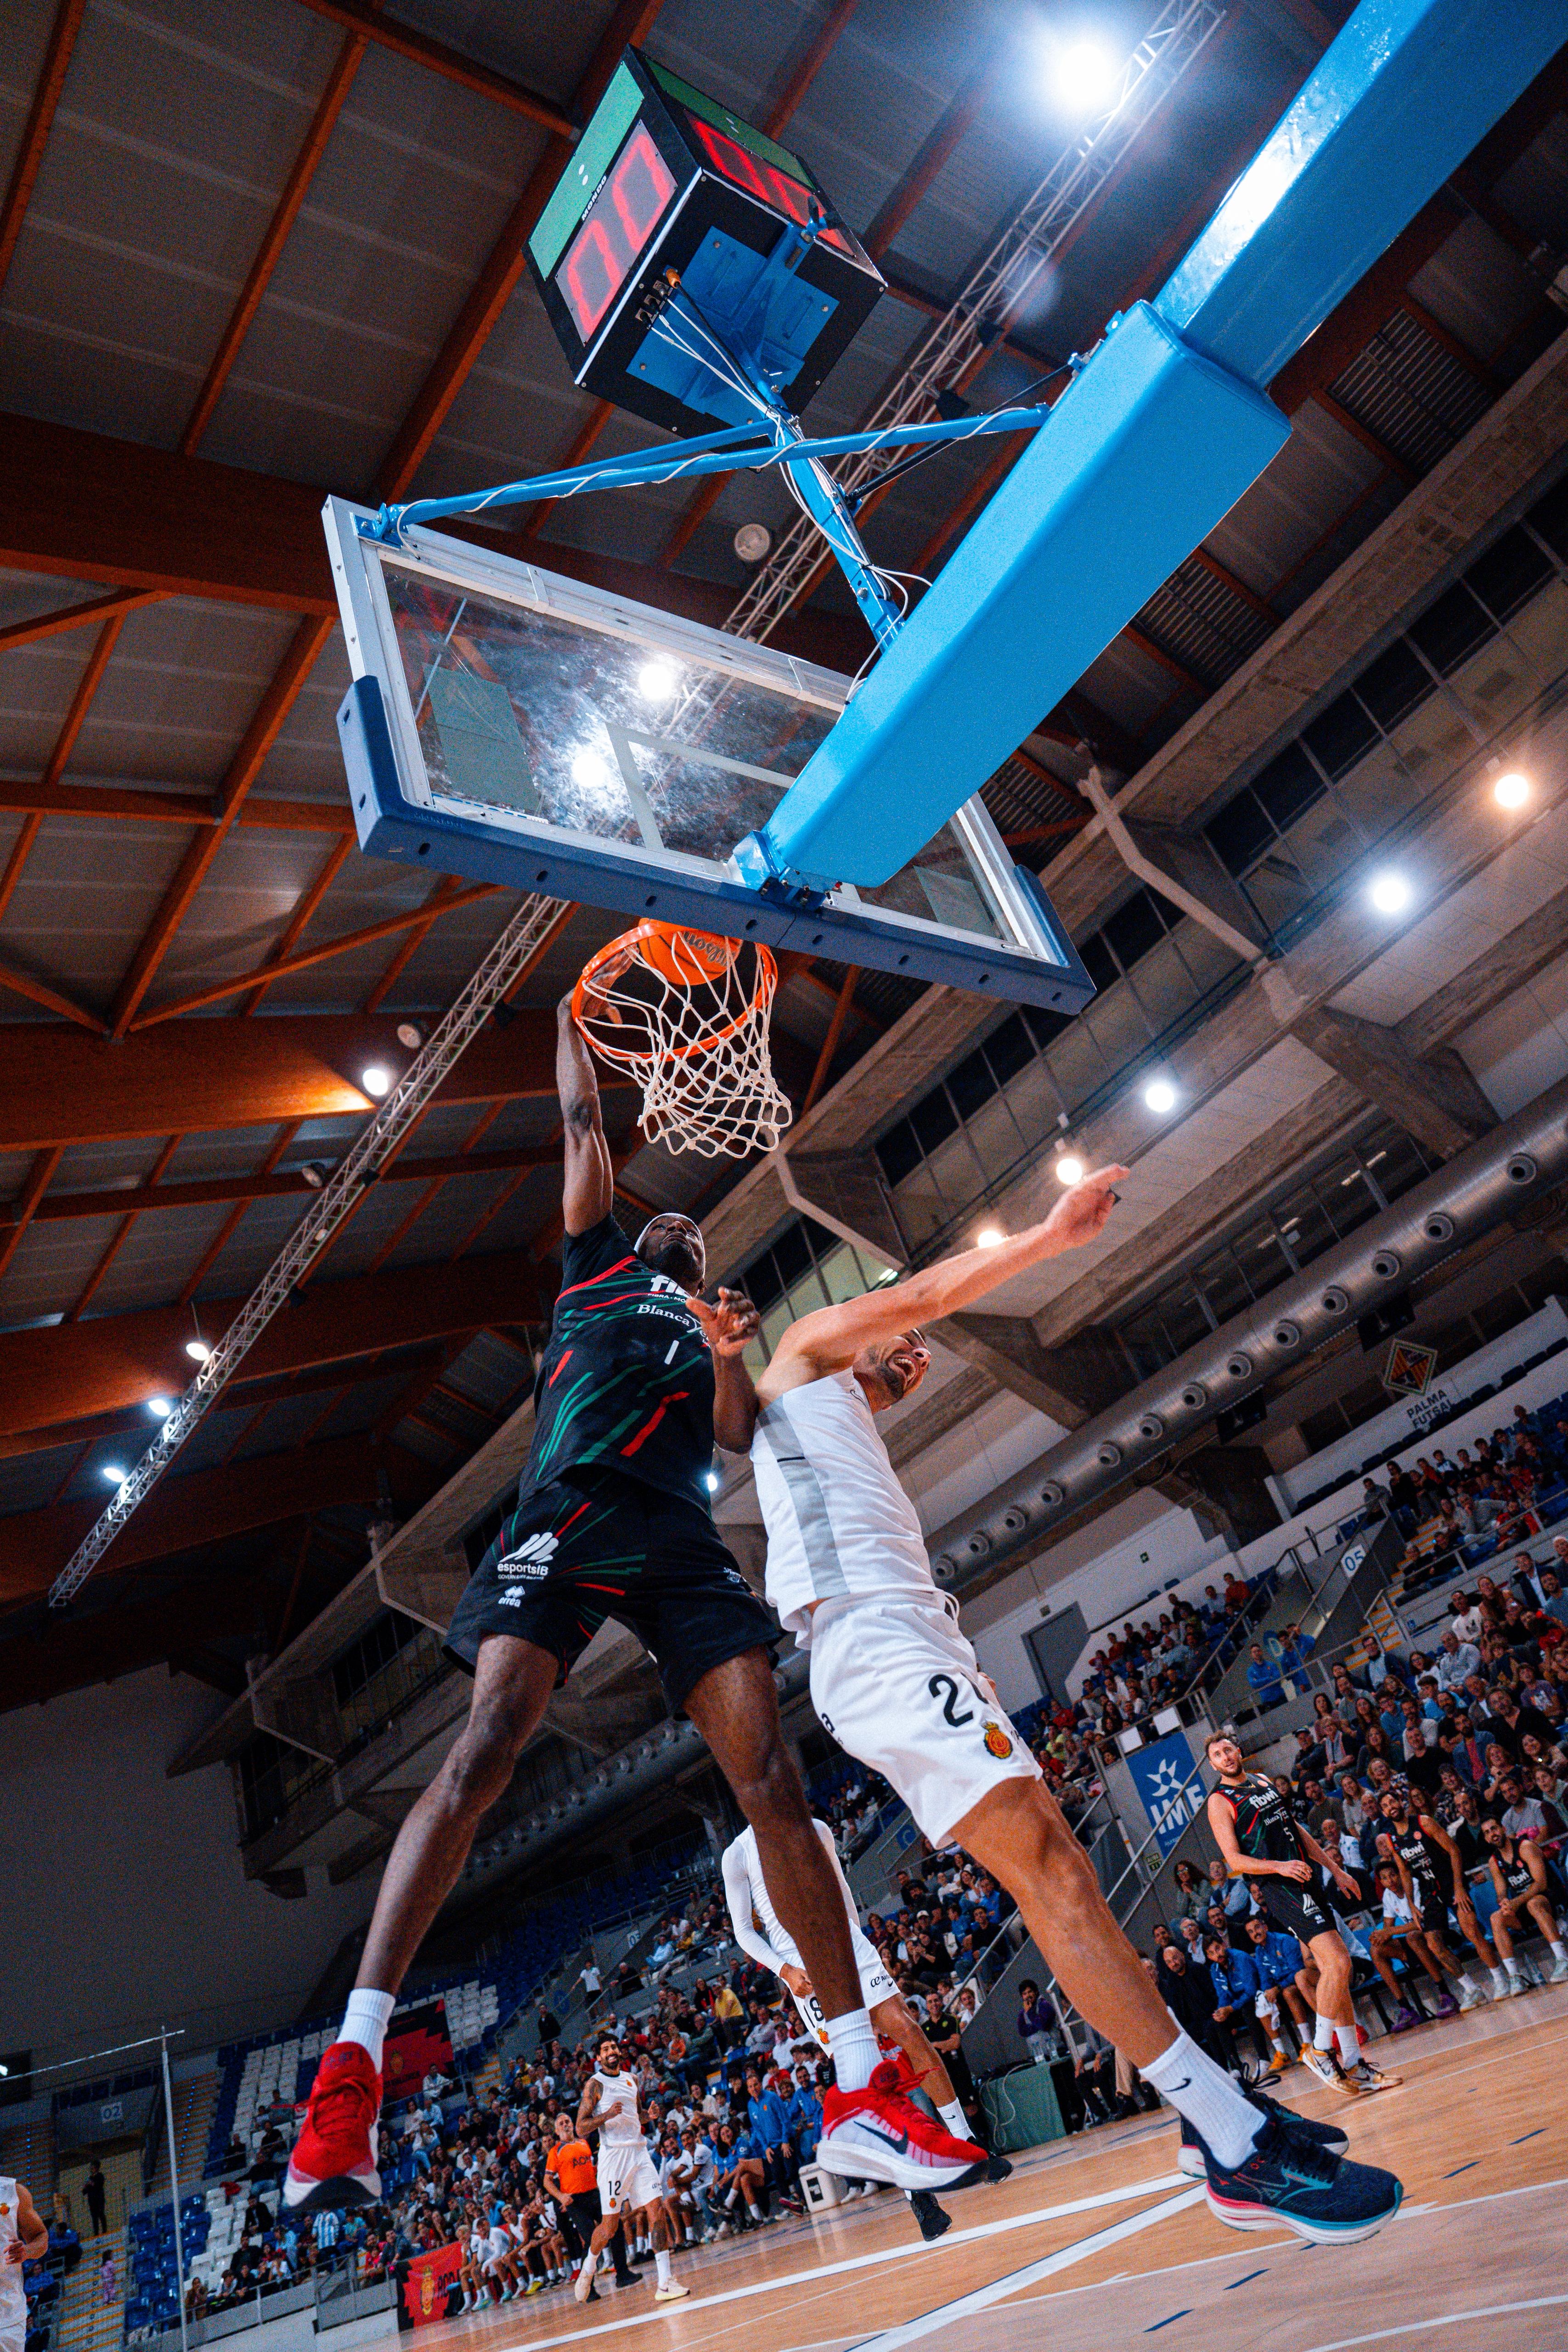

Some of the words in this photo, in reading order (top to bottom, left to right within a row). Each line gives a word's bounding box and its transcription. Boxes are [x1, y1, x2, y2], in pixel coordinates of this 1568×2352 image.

[581, 175, 607, 222] MONDO
[637, 1304, 690, 1327] Blanca
[1406, 1389, 1447, 1419] PALMA
[497, 1563, 549, 1577] esportsIB
[1248, 1787, 1279, 1809] fibwi
[1283, 1826, 1295, 1842] 5
[609, 2180, 621, 2196] 12
